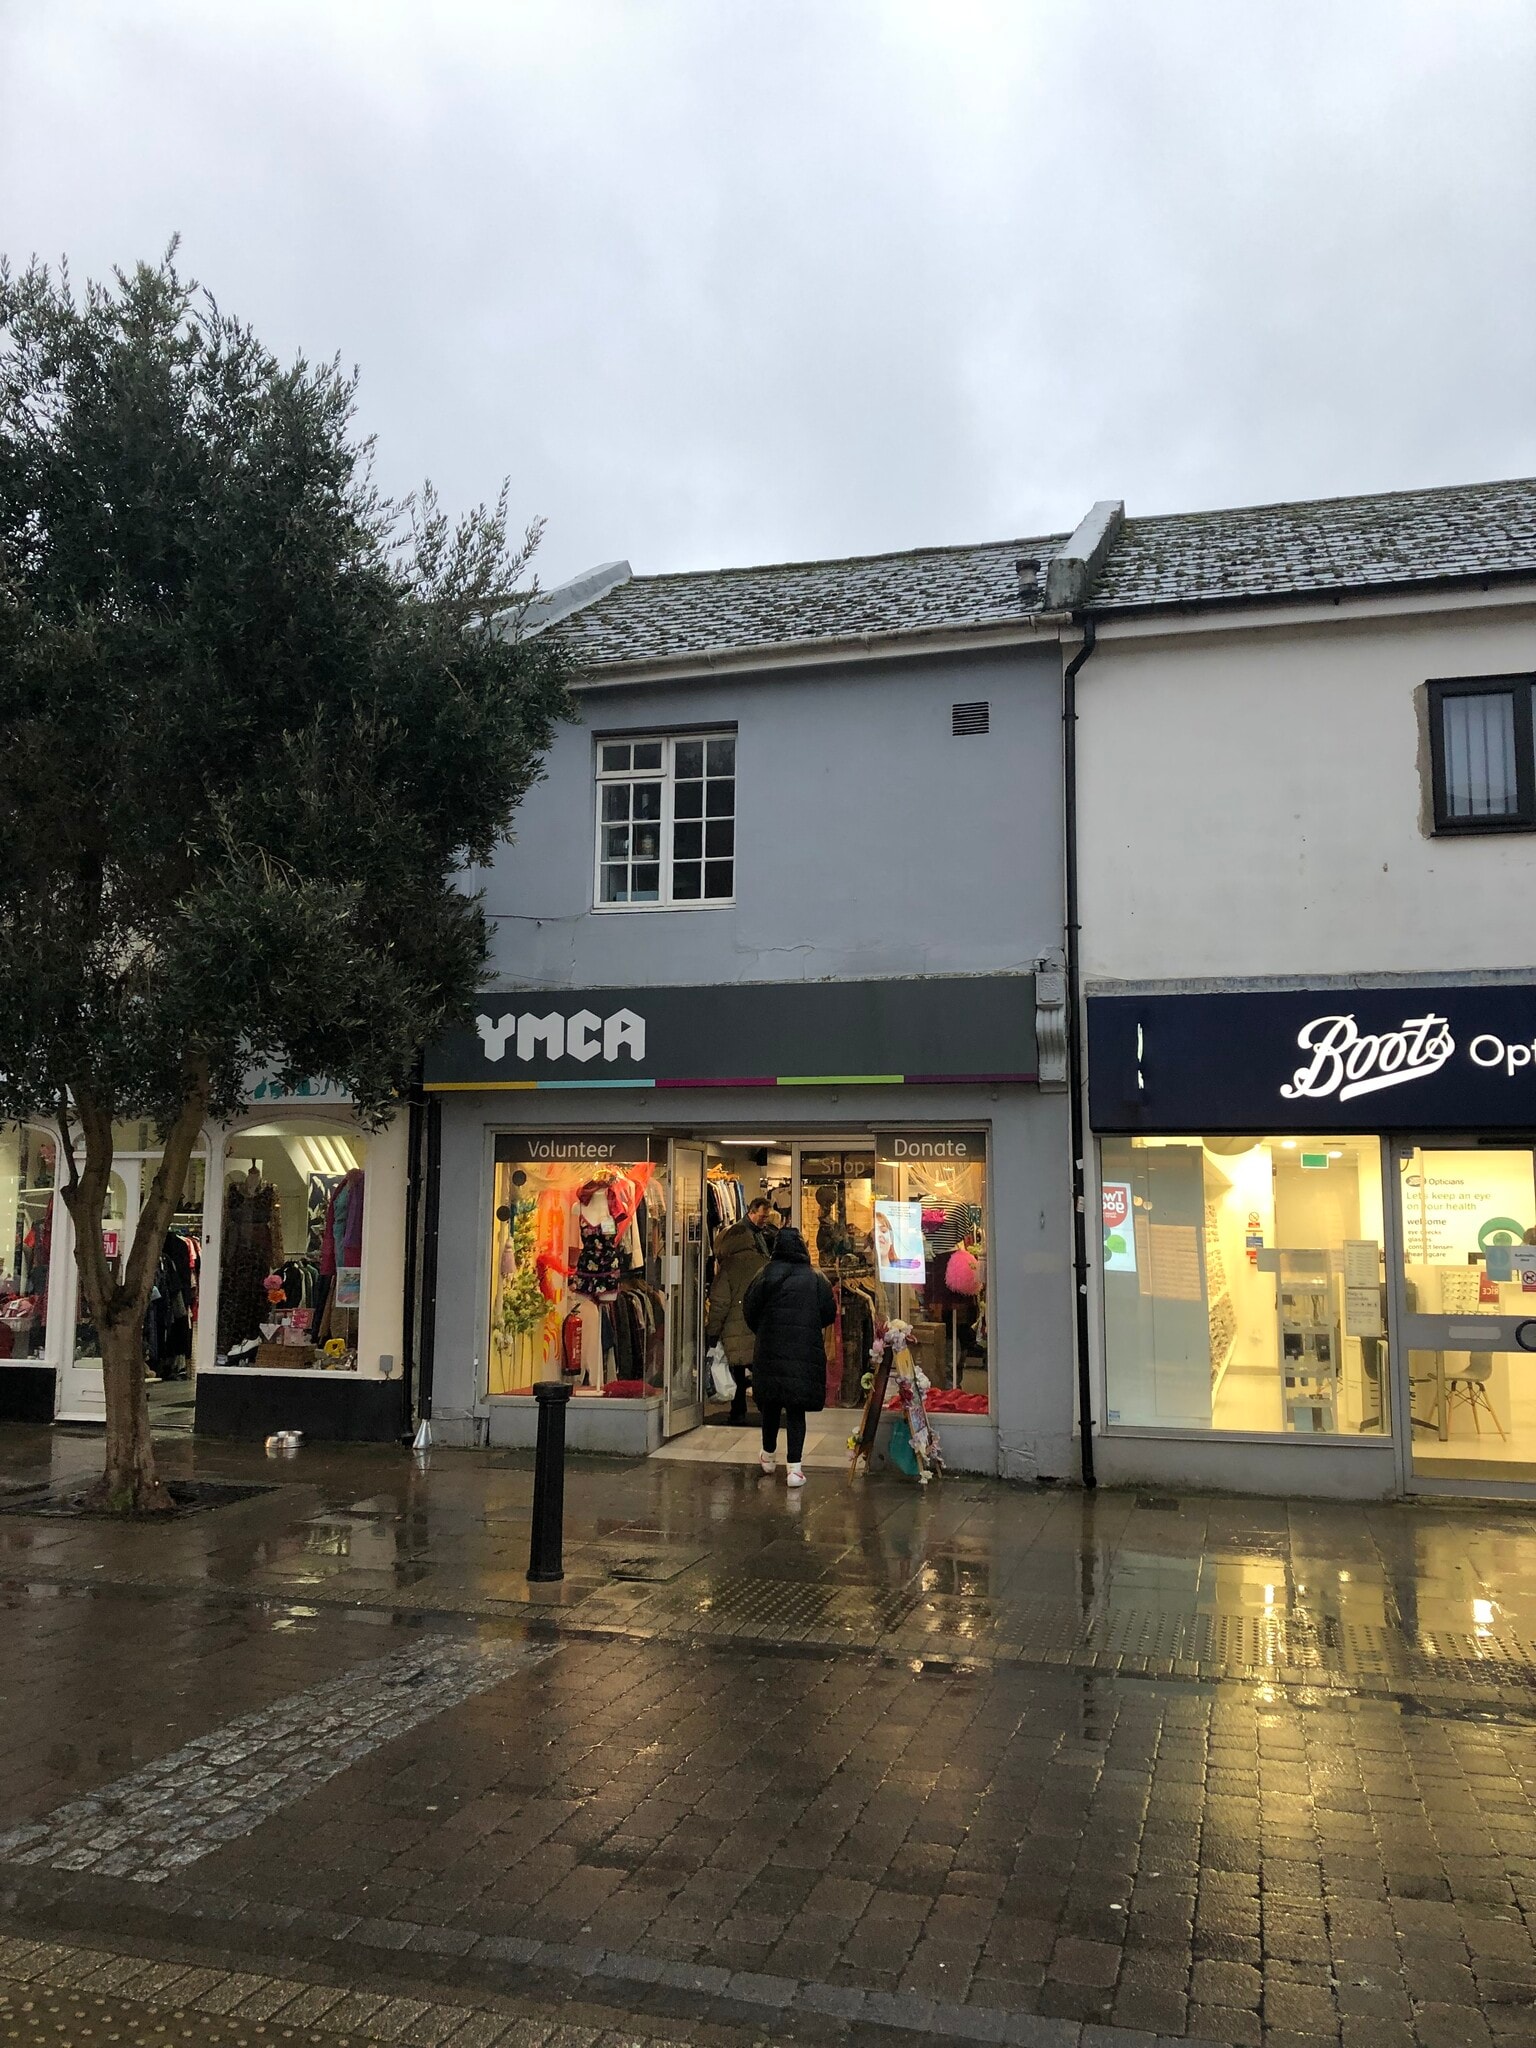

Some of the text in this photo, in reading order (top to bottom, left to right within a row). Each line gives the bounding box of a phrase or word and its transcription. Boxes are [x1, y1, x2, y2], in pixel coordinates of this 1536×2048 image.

[475, 1007, 646, 1063] YMCA
[1280, 1013, 1456, 1102] Boots
[527, 1139, 617, 1158] Volunteer
[894, 1138, 967, 1157] Donate
[821, 1157, 865, 1177] Shop
[1428, 1177, 1465, 1186] Opticians
[1431, 1191, 1456, 1201] keep
[1446, 1202, 1477, 1211] health
[1407, 1218, 1447, 1226] welome
